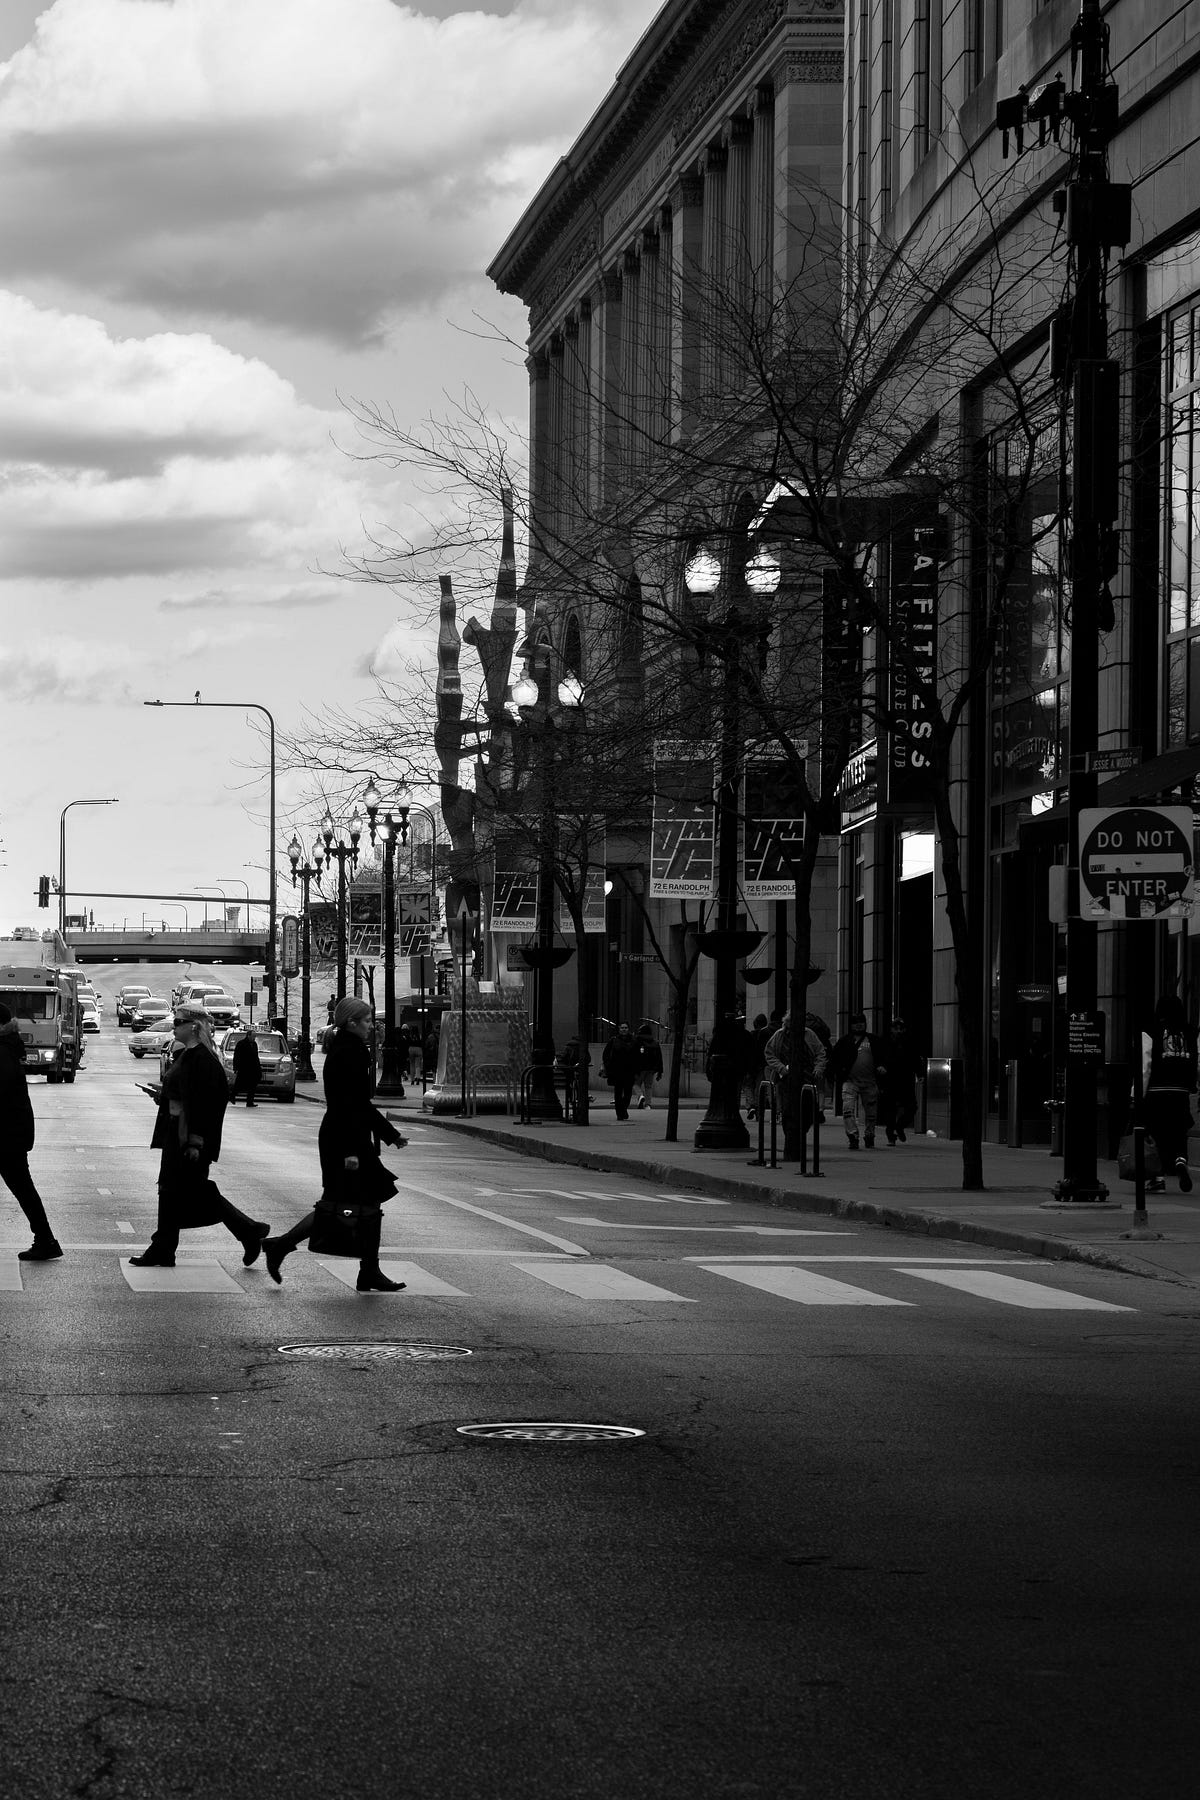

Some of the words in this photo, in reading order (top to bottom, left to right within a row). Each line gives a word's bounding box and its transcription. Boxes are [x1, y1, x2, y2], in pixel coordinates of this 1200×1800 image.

[1097, 831, 1123, 848] DO
[1136, 830, 1175, 847] NOT
[1106, 879, 1167, 897] ENTER
[629, 954, 654, 962] Garland
